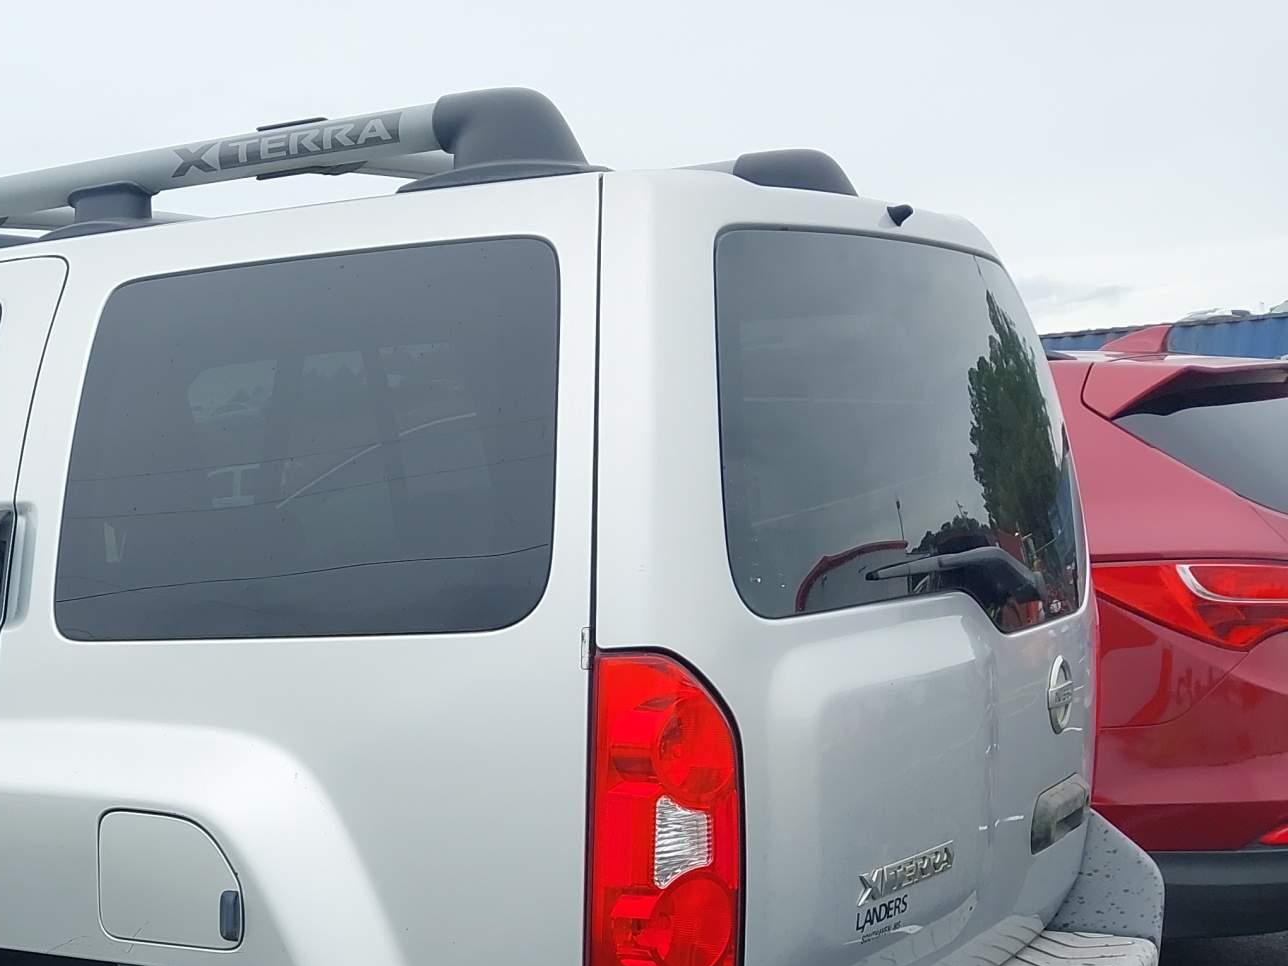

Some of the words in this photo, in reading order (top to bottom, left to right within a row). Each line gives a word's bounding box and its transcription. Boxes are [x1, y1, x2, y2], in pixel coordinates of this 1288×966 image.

[171, 116, 396, 179] XTERRA
[857, 843, 954, 907] XTERRA
[855, 894, 909, 933] LANDERS
